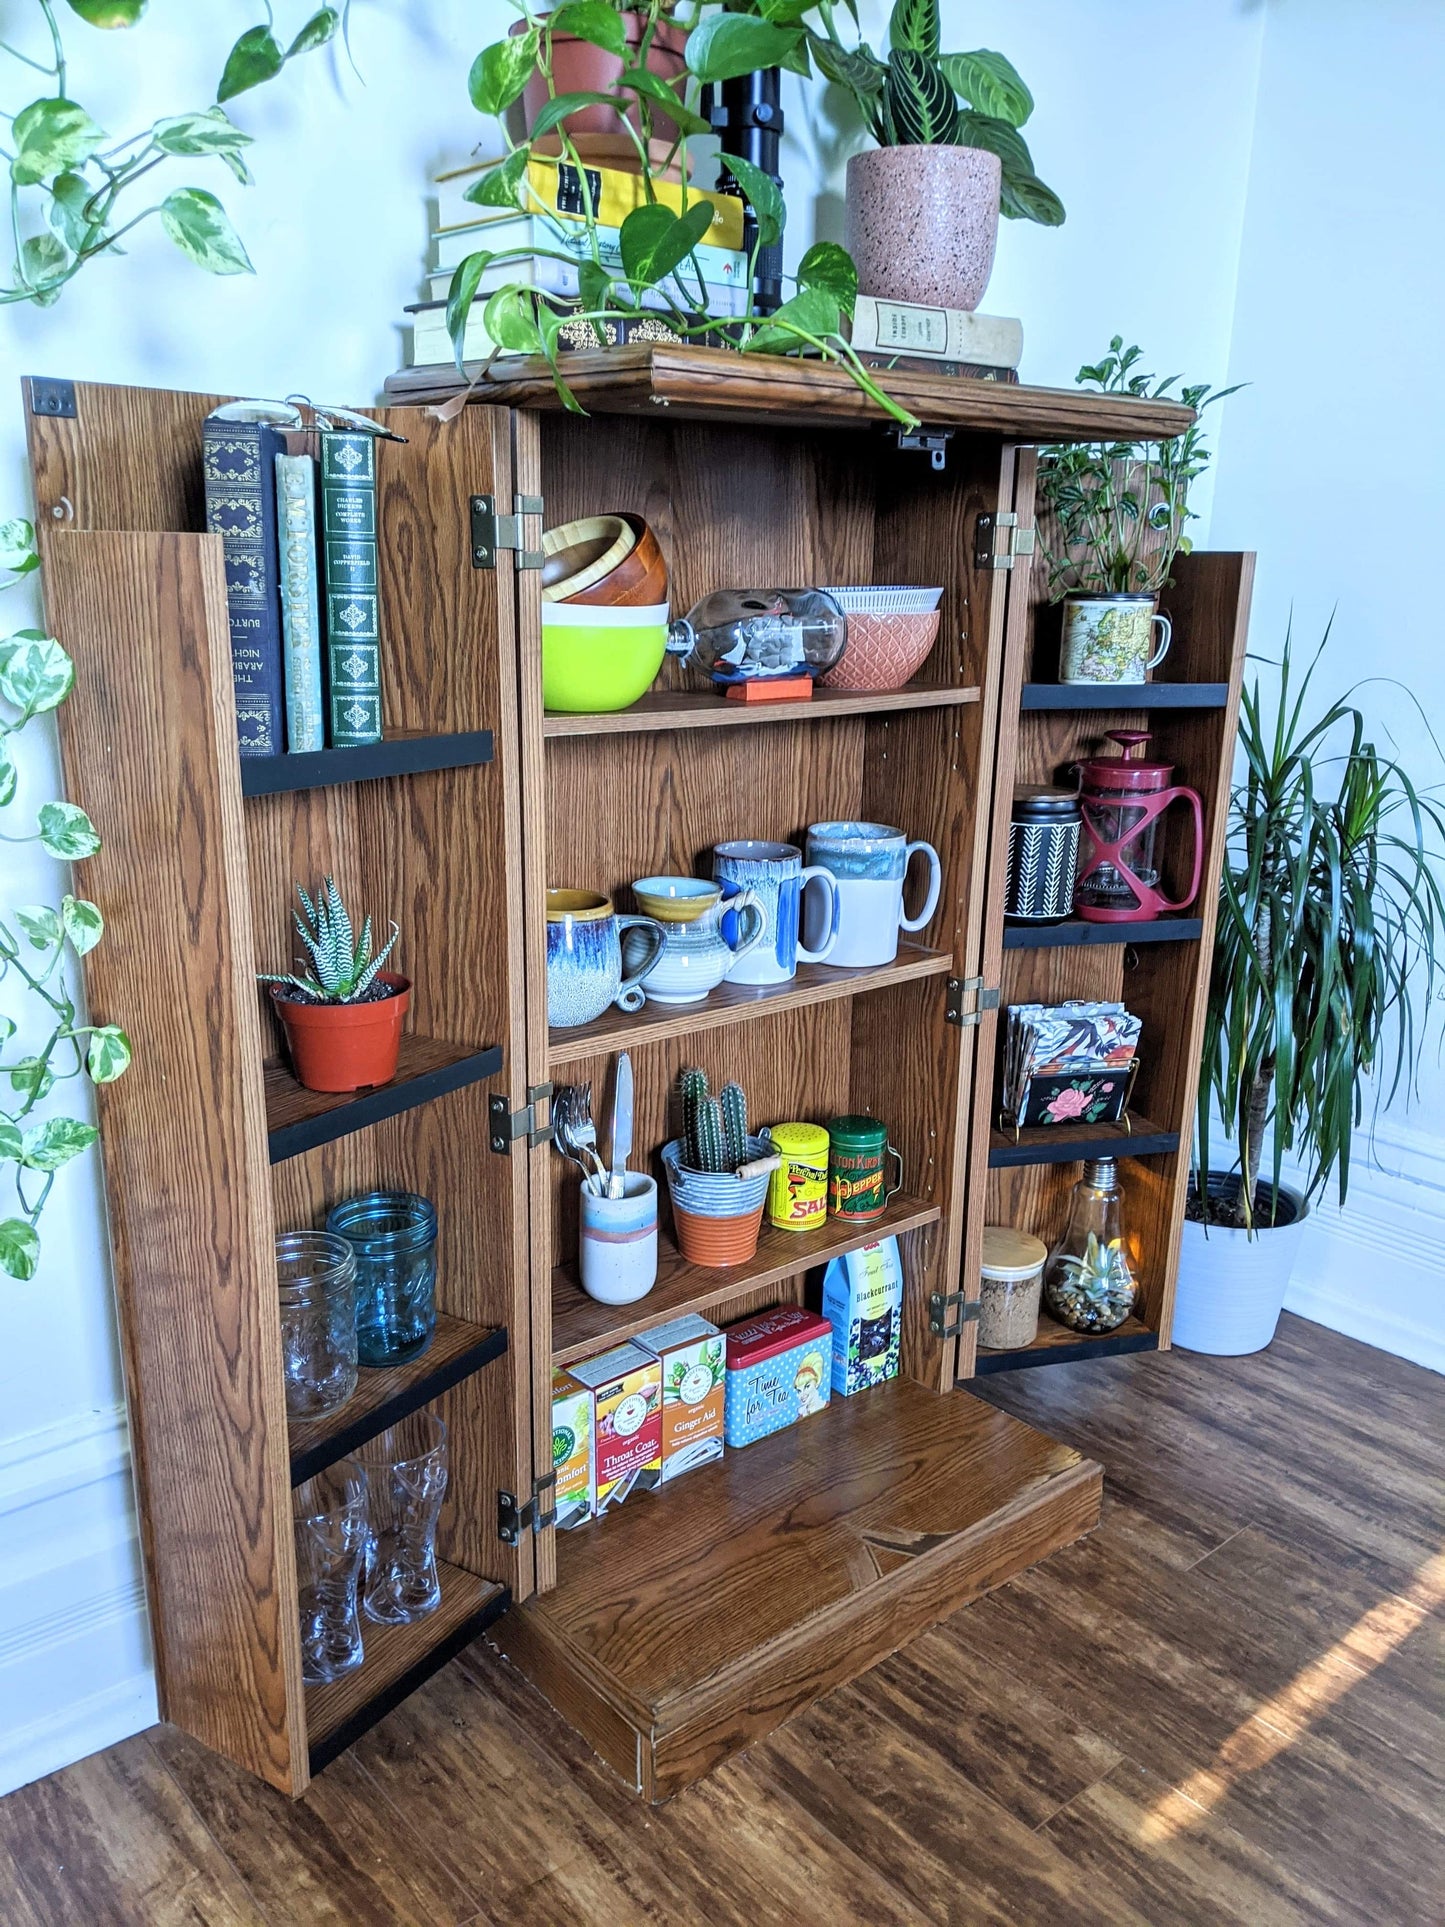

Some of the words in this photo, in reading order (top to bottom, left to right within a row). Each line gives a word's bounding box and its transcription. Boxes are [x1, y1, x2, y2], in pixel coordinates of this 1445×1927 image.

[229, 618, 261, 628] BURTO
[232, 649, 260, 658] NIGH
[232, 662, 264, 670] ARABI
[233, 674, 253, 682] THE
[295, 702, 304, 751] STORIES
[835, 1171, 883, 1215] PEPPER
[790, 1195, 827, 1219] SAL
[856, 1280, 899, 1303] Blackcurrant
[748, 1374, 780, 1395] Time
[688, 1404, 705, 1414] organic
[746, 1398, 764, 1424] for
[766, 1386, 790, 1406] Tea
[674, 1416, 702, 1433] Ginger
[702, 1408, 716, 1422] Aid
[622, 1435, 640, 1446] organic
[604, 1450, 634, 1468] Throat
[635, 1439, 656, 1454] Coat
[557, 1464, 570, 1476] anic
